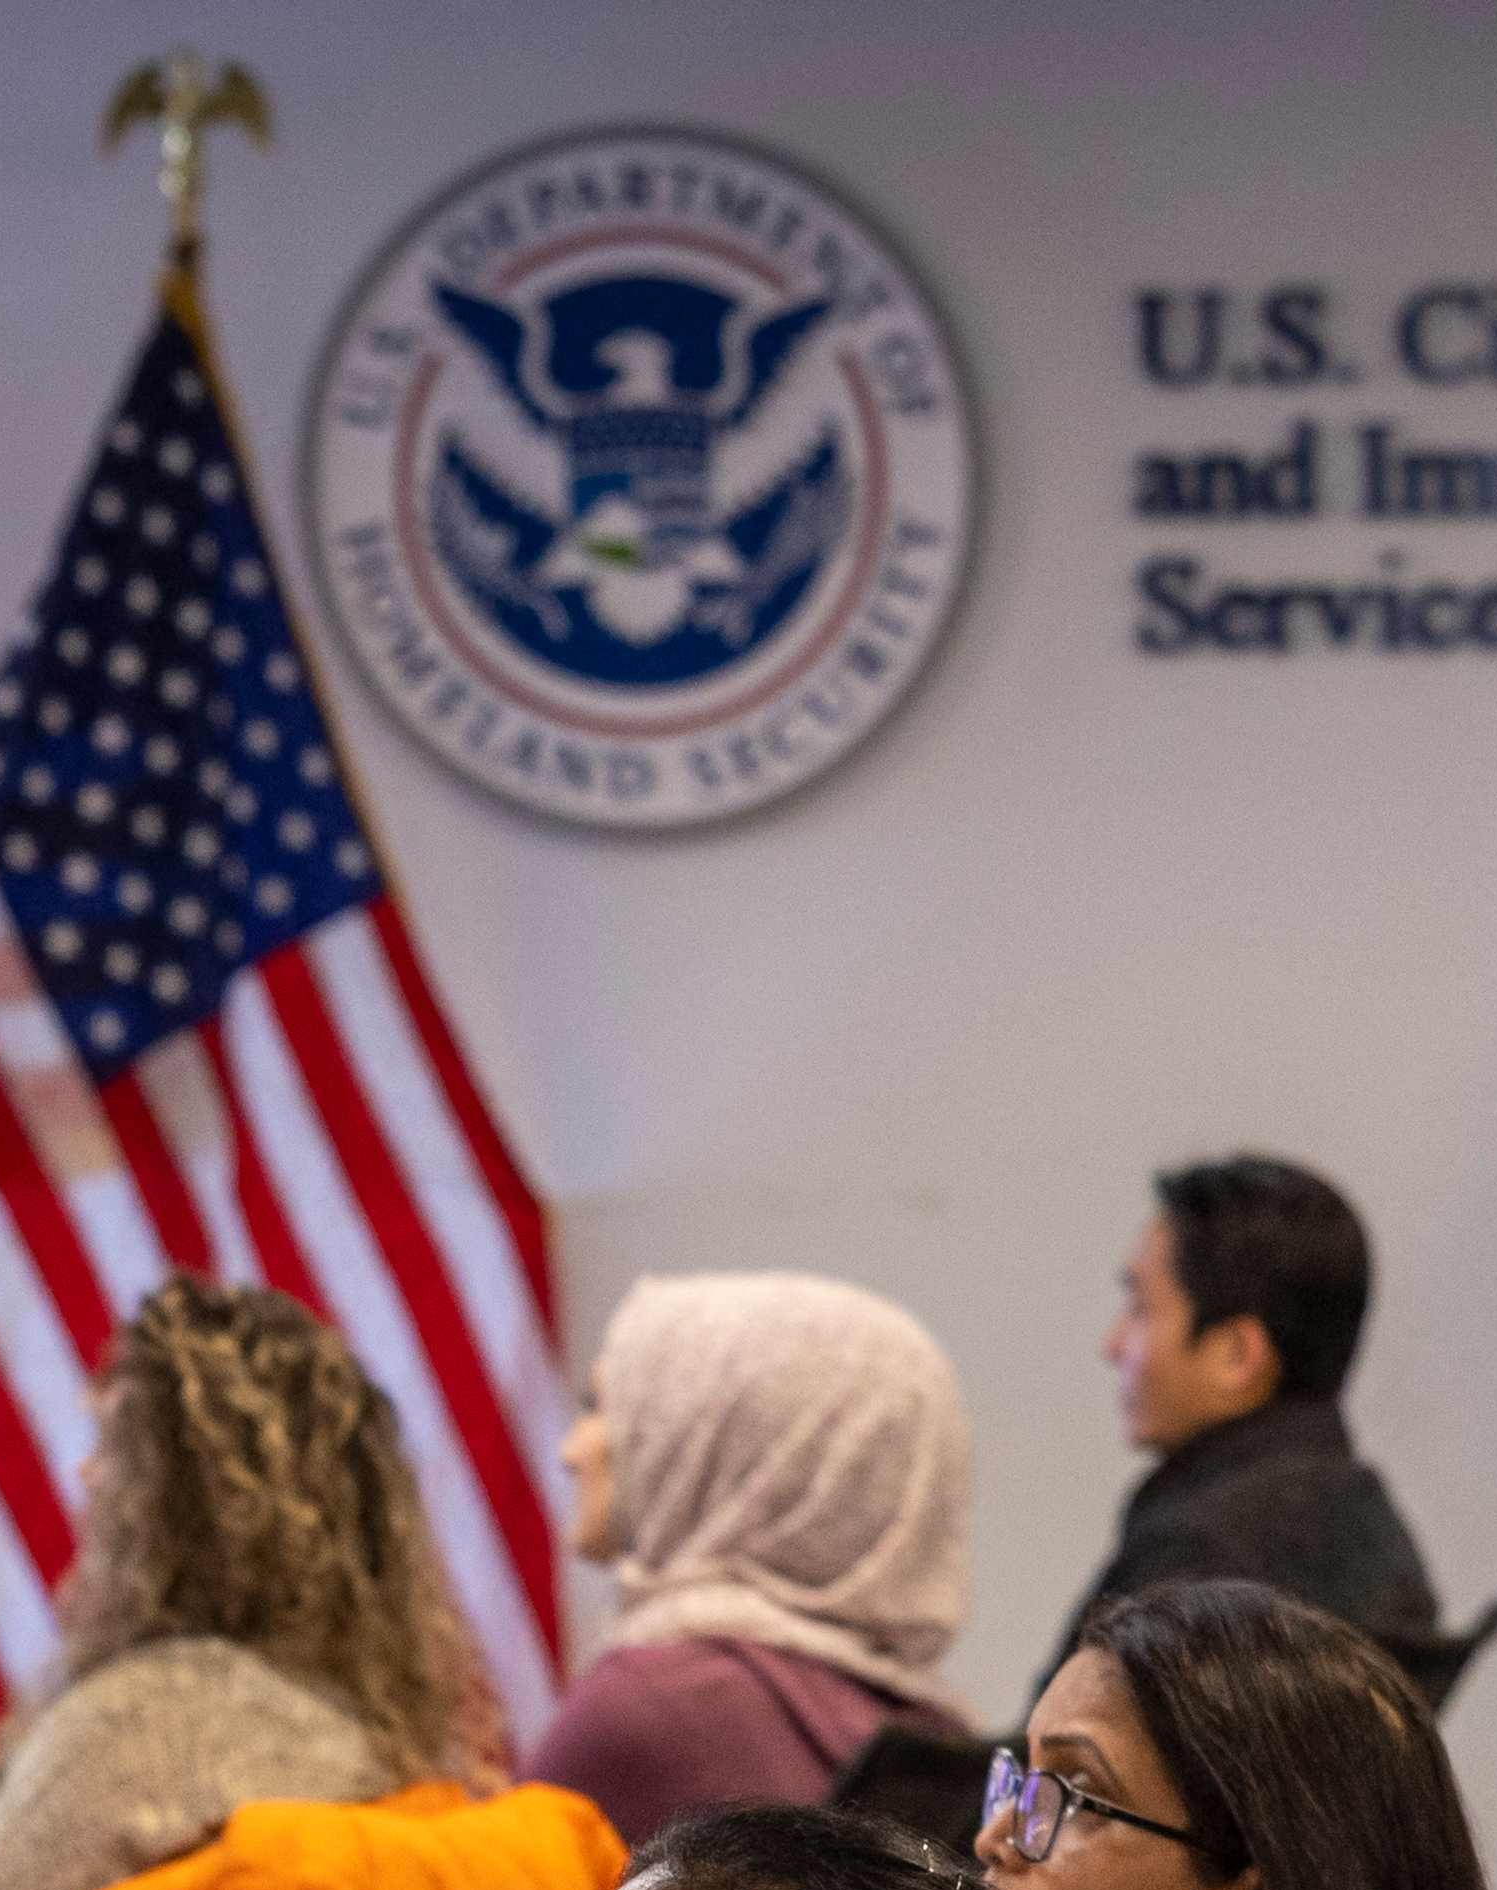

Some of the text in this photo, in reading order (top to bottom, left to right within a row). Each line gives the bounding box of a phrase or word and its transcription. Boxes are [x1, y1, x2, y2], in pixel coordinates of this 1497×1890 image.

[440, 160, 890, 322] DEPARTMENT
[872, 328, 937, 418] OF
[1134, 282, 1362, 387] U.S.
[1134, 422, 1319, 522] and
[338, 515, 943, 802] HOMELAND SECURITY
